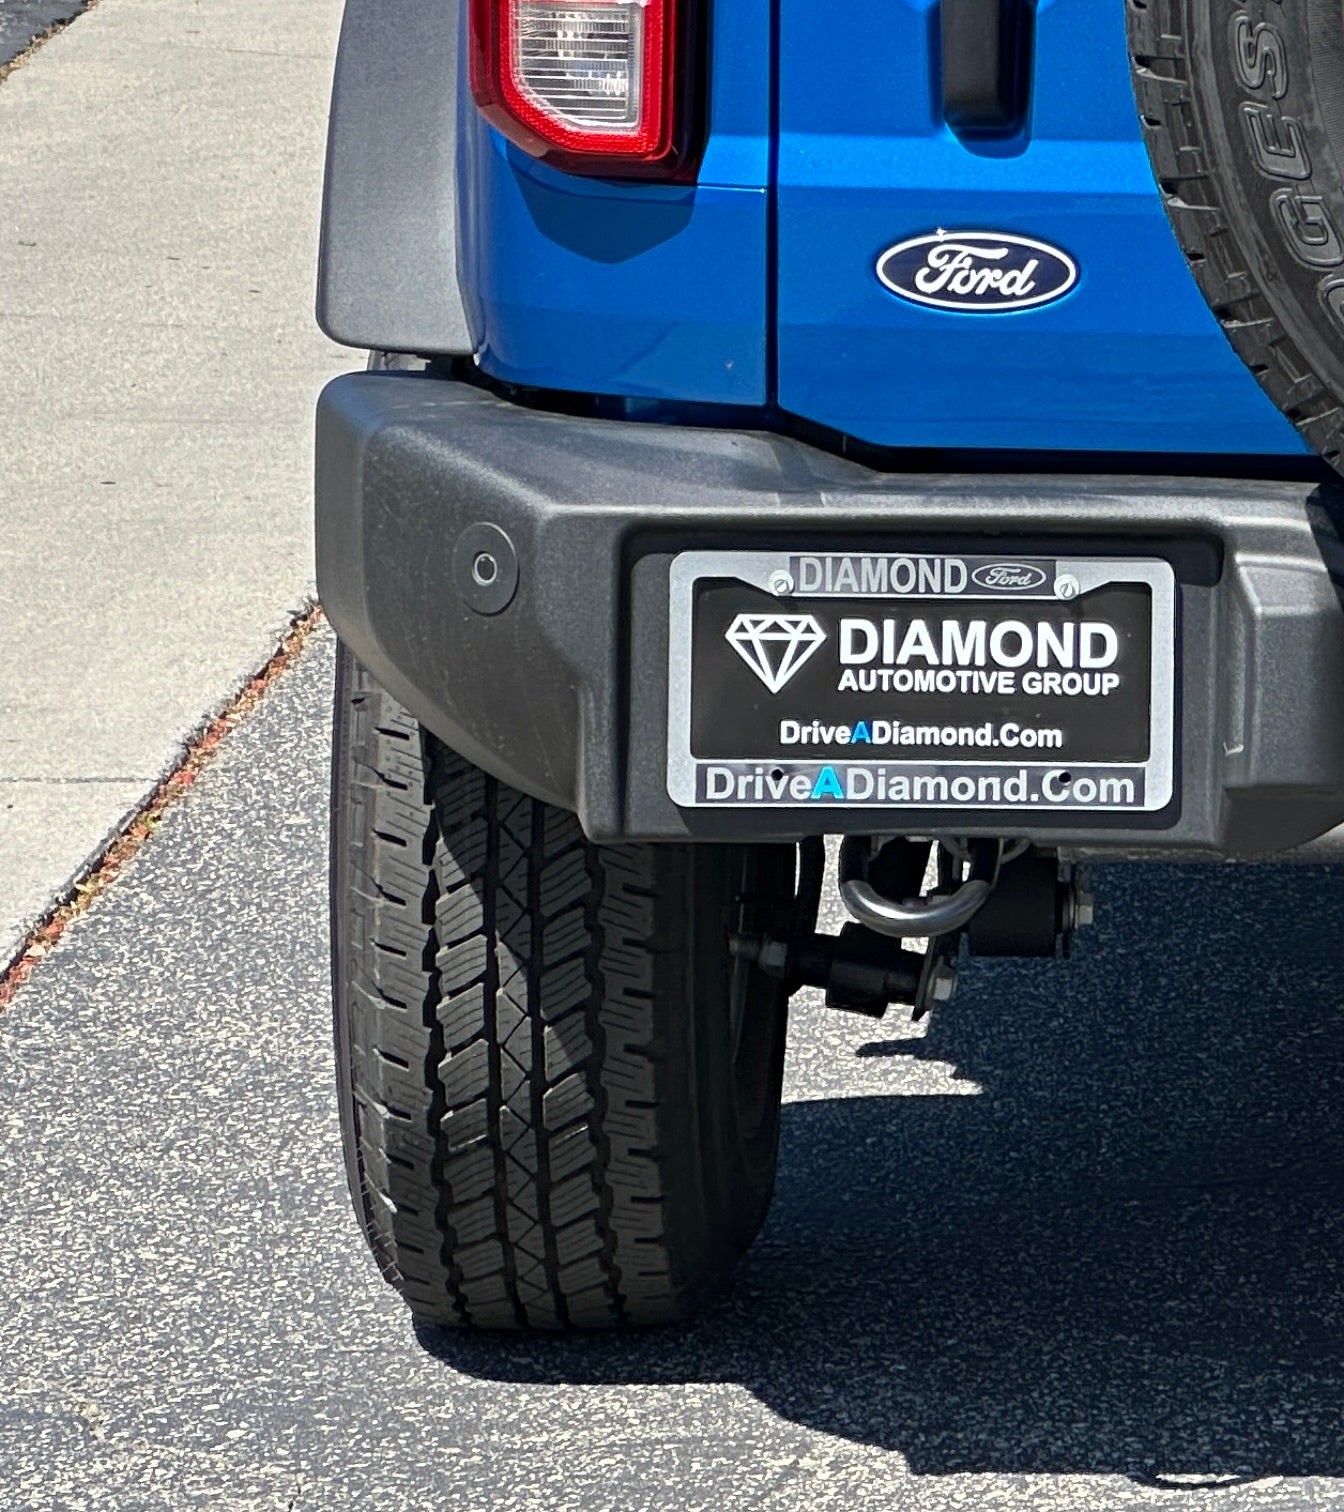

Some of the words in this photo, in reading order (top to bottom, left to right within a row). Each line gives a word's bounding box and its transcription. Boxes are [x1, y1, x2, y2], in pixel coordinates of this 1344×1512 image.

[915, 244, 1039, 296] Ford
[799, 557, 968, 594] DIAMOND
[839, 618, 1118, 669] DIAMOND
[837, 669, 1015, 694] AUTOMOTIVE
[1022, 671, 1120, 695] GROUP
[779, 720, 1064, 748] DriveADiamond.Com
[705, 765, 1135, 804] DriveADiamond.Com
